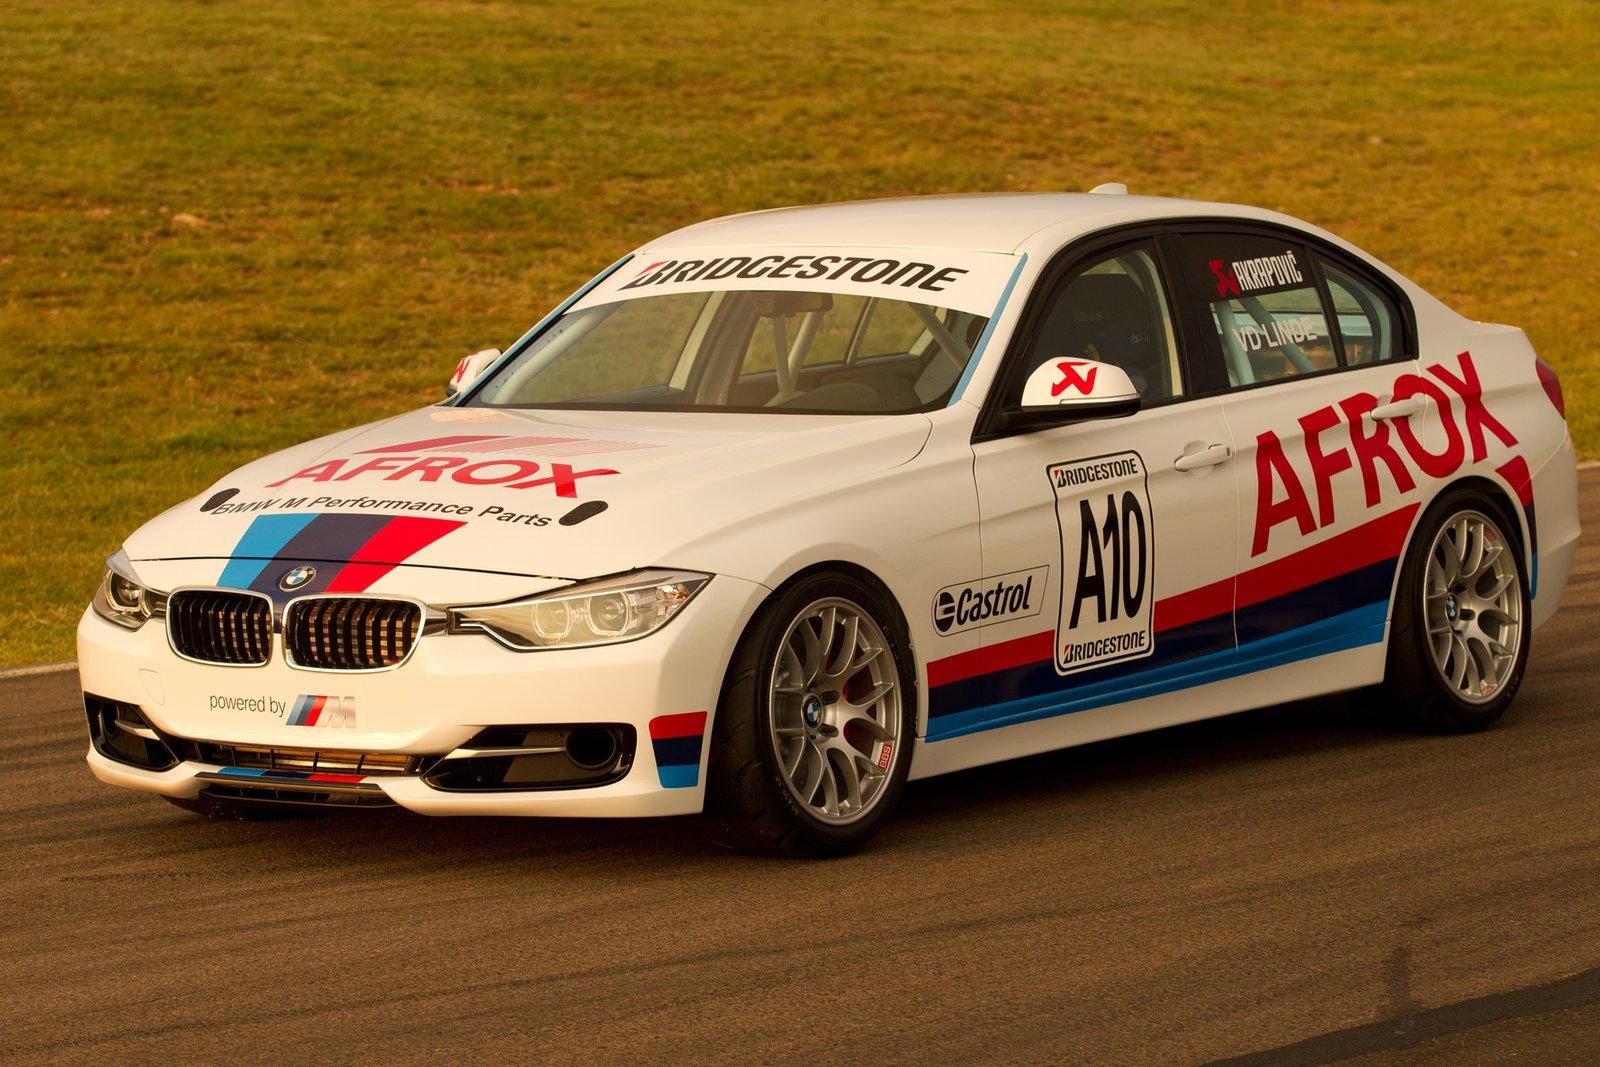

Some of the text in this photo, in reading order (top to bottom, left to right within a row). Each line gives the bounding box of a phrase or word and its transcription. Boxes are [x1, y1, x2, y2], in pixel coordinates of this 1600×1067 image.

[618, 256, 969, 292] BRIDGESTONE
[1262, 317, 1318, 348] LINDE
[1251, 351, 1519, 558] AFROX
[265, 457, 622, 498] AFROX
[1054, 458, 1138, 488] BRIDGESTONE
[210, 496, 552, 527] BMW M Performance Parts
[1069, 491, 1147, 630] A10
[957, 575, 1033, 626] Castrol
[1063, 630, 1145, 664] BRIDGESTONE
[209, 695, 266, 713] powered
[269, 696, 286, 718] by
[879, 745, 892, 769] BBS
